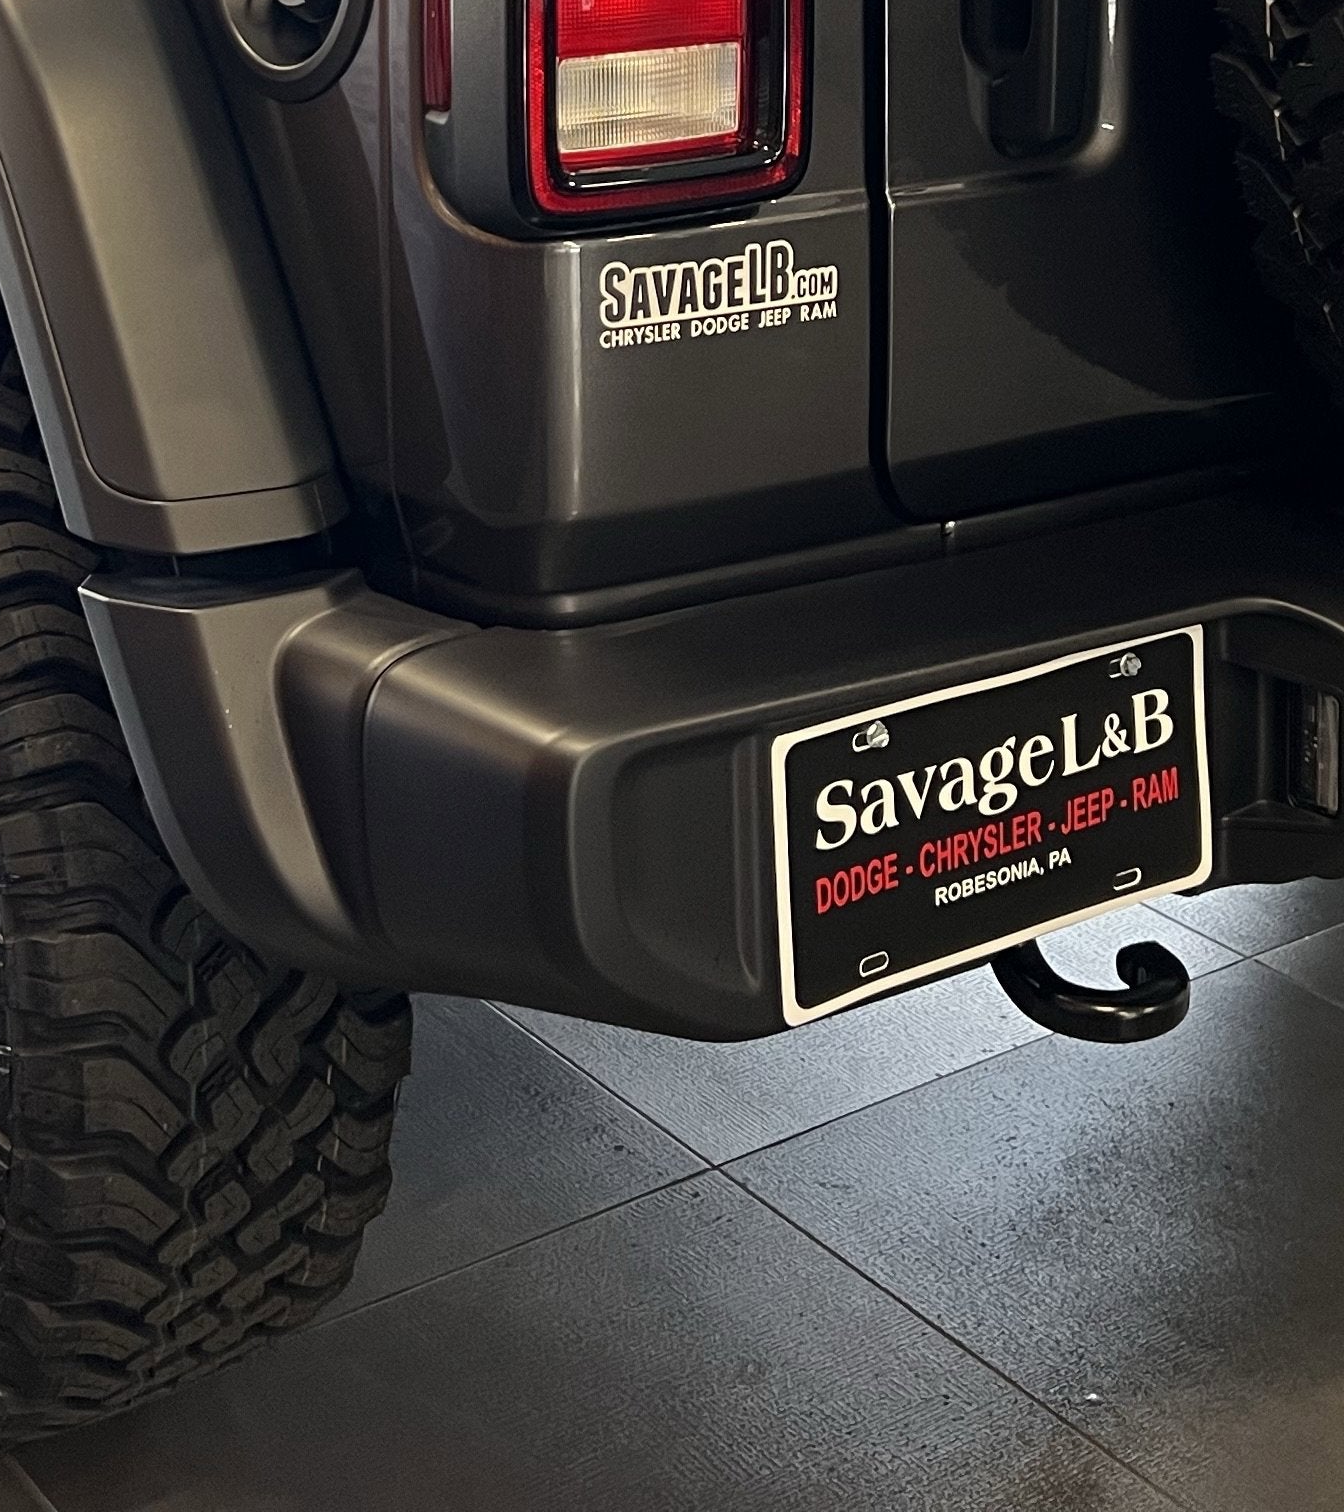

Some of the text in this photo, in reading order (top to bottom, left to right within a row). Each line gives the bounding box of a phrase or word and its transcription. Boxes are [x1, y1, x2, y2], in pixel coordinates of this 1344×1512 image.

[599, 300, 837, 349] CHRYSLER DODGE JEEP RAM
[815, 853, 899, 914] DODGE
[919, 811, 1041, 878] CHRYSLER
[1061, 787, 1114, 836] JEEP
[1131, 766, 1179, 812] RAM
[934, 847, 1072, 907] ROBESONIA, PA
